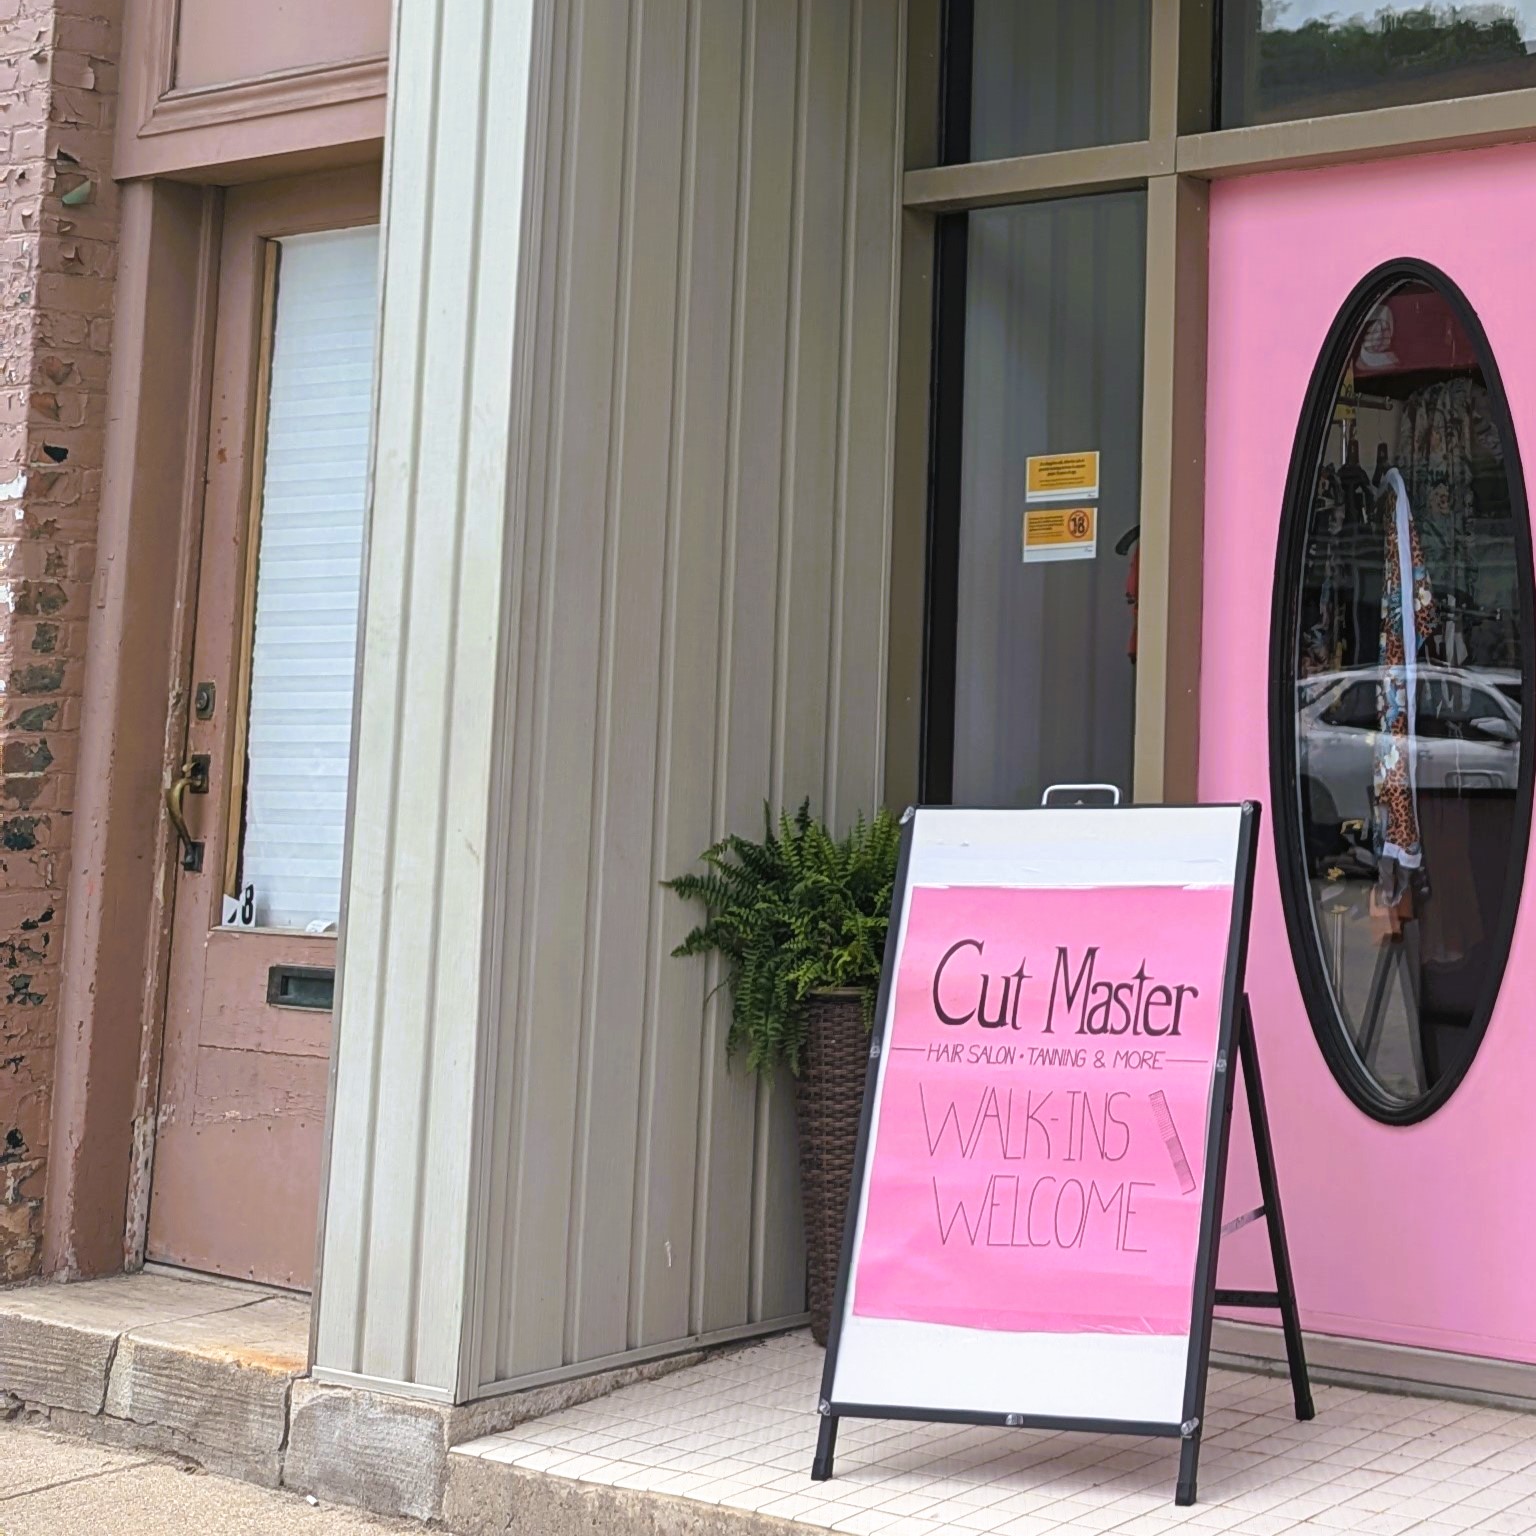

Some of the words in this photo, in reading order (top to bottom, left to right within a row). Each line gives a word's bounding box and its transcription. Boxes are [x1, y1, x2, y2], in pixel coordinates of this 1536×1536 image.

[932, 938, 1033, 1031] Cut
[1041, 946, 1199, 1037] Master
[927, 1043, 963, 1063] HAIR
[966, 1044, 1017, 1065] SALON
[1027, 1047, 1087, 1069] TANNING
[1093, 1050, 1106, 1069] &
[1113, 1050, 1167, 1070] MORE
[919, 1082, 1132, 1162] WALK-INS
[932, 1174, 1156, 1253] WELCOME
